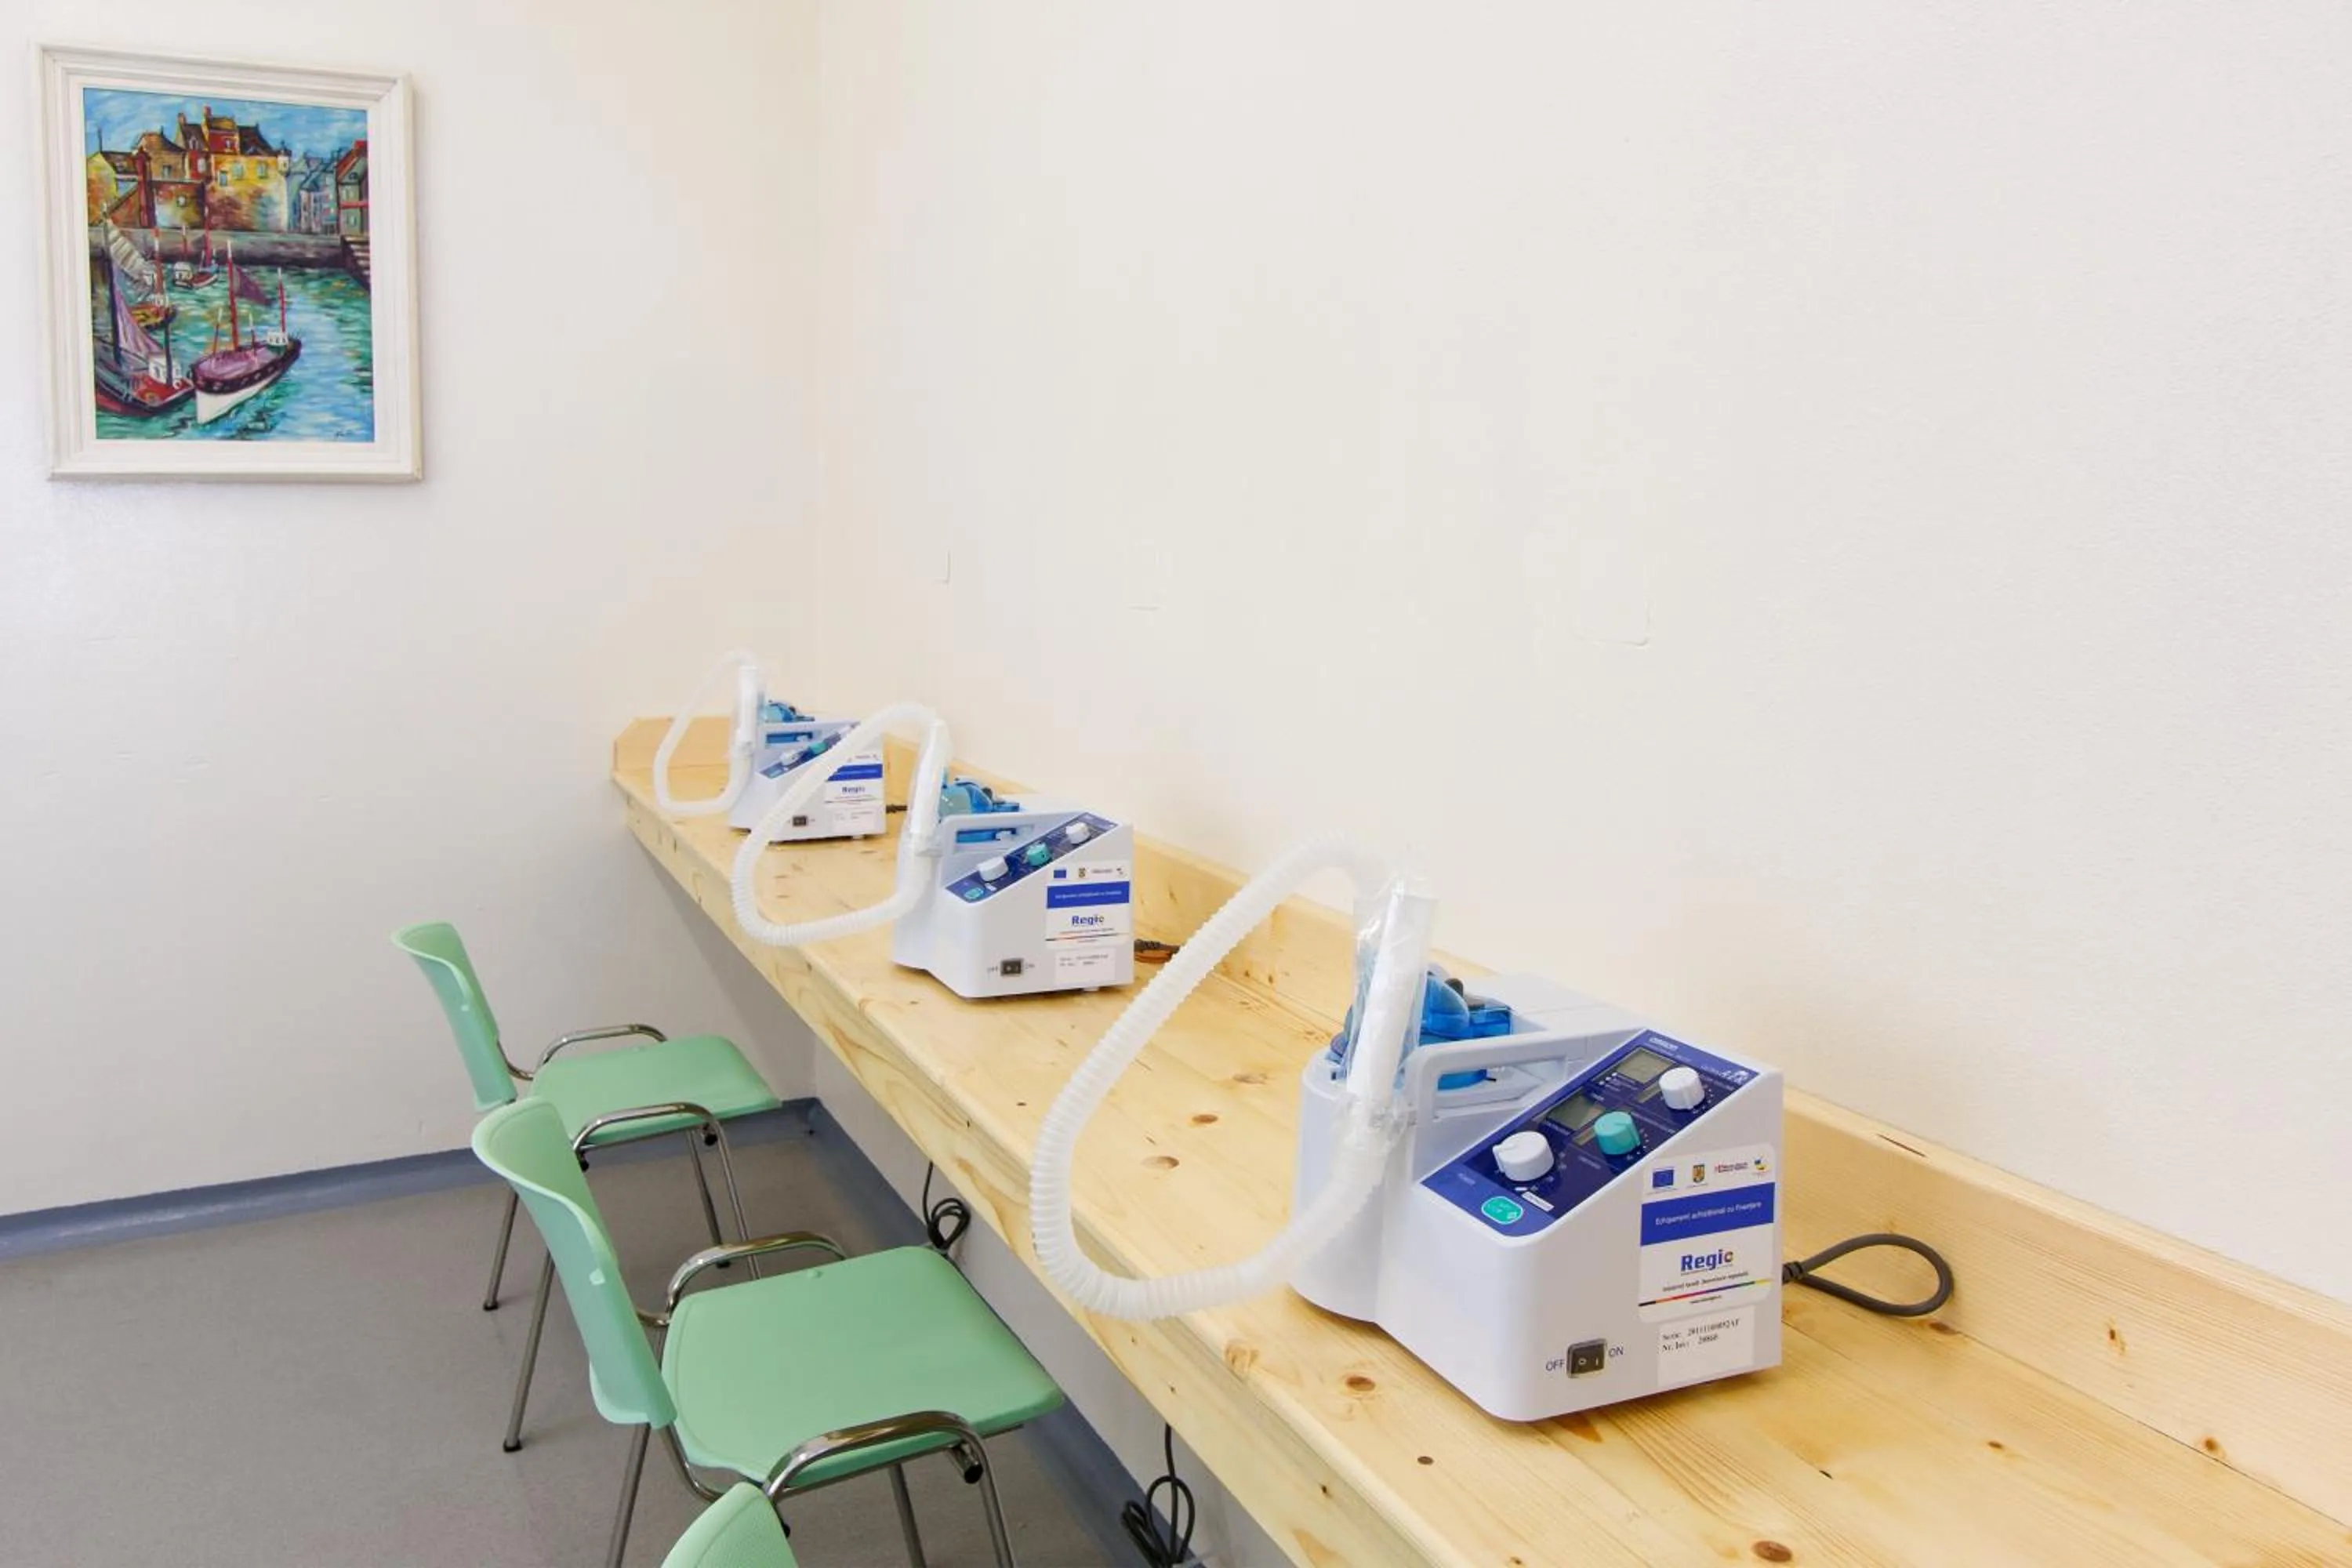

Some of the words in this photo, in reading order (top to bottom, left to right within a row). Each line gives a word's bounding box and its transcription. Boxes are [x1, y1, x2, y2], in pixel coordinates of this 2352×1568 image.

[1680, 1249, 1734, 1271] Regio
[1609, 1346, 1624, 1357] ON
[1545, 1359, 1565, 1371] OFF
